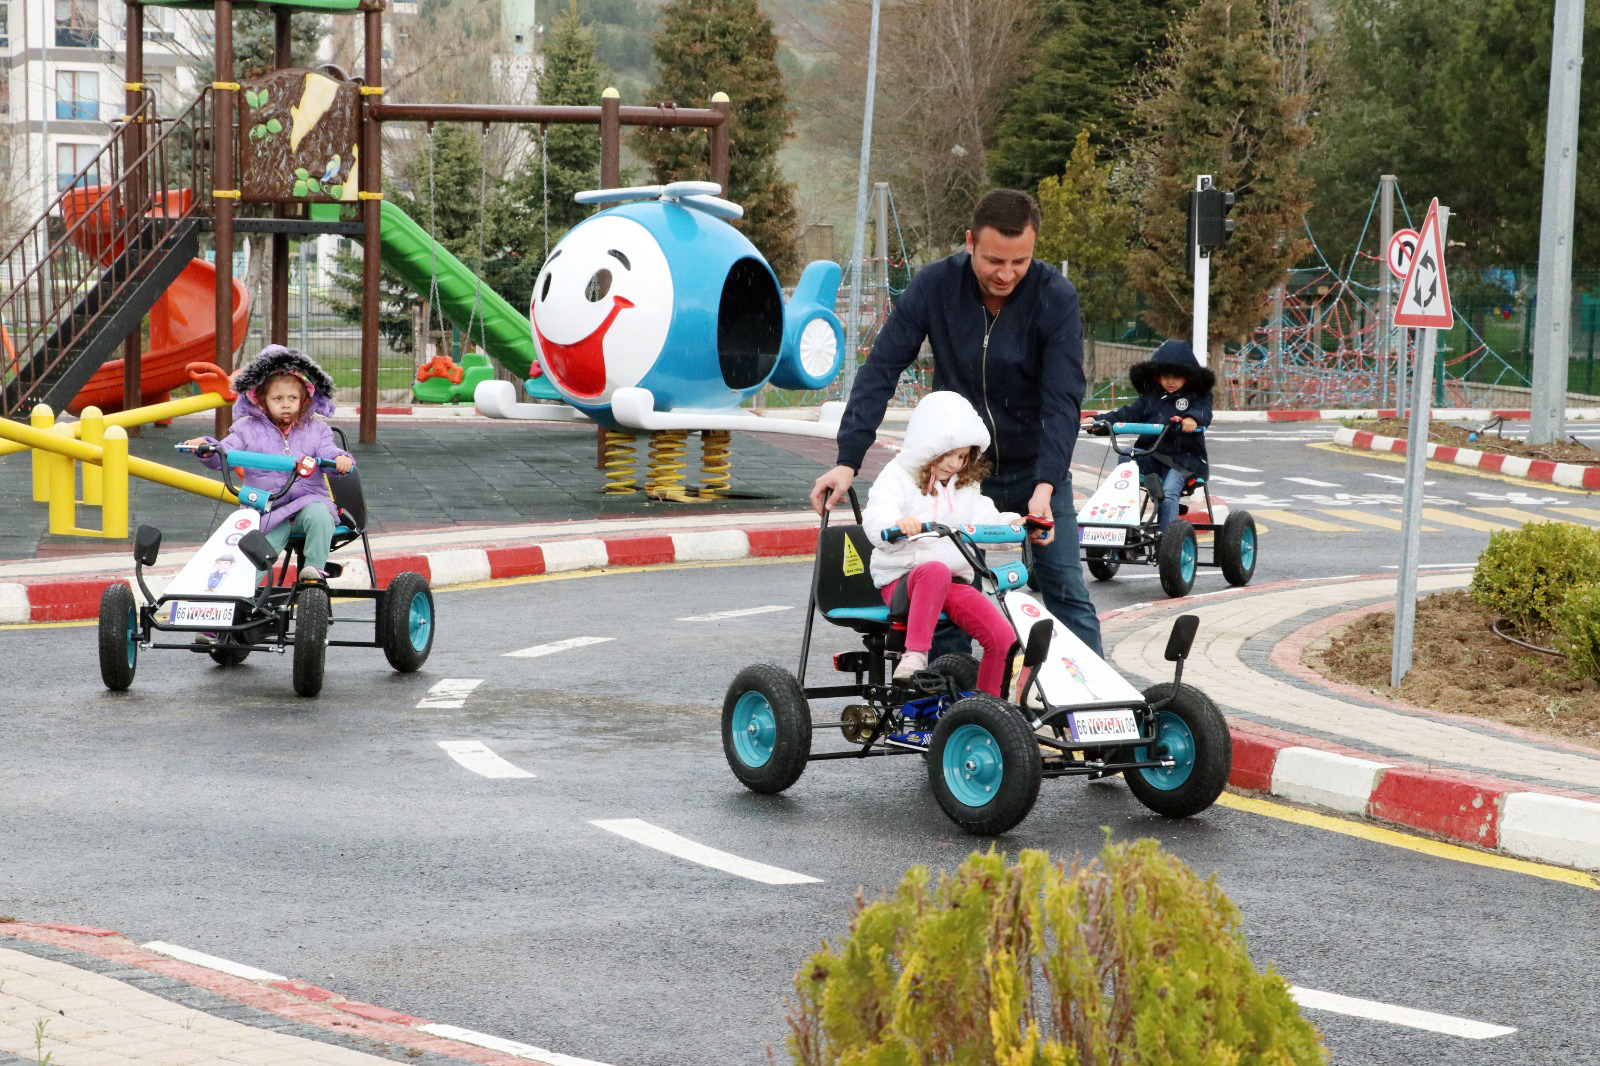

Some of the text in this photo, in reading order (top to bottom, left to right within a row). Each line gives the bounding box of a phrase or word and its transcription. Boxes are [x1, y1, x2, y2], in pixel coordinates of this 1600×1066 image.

[1091, 531, 1117, 541] YOZGAT
[176, 607, 233, 621] 66 YOZGAT 05
[1077, 717, 1137, 735] 66 YOZGAT 09
